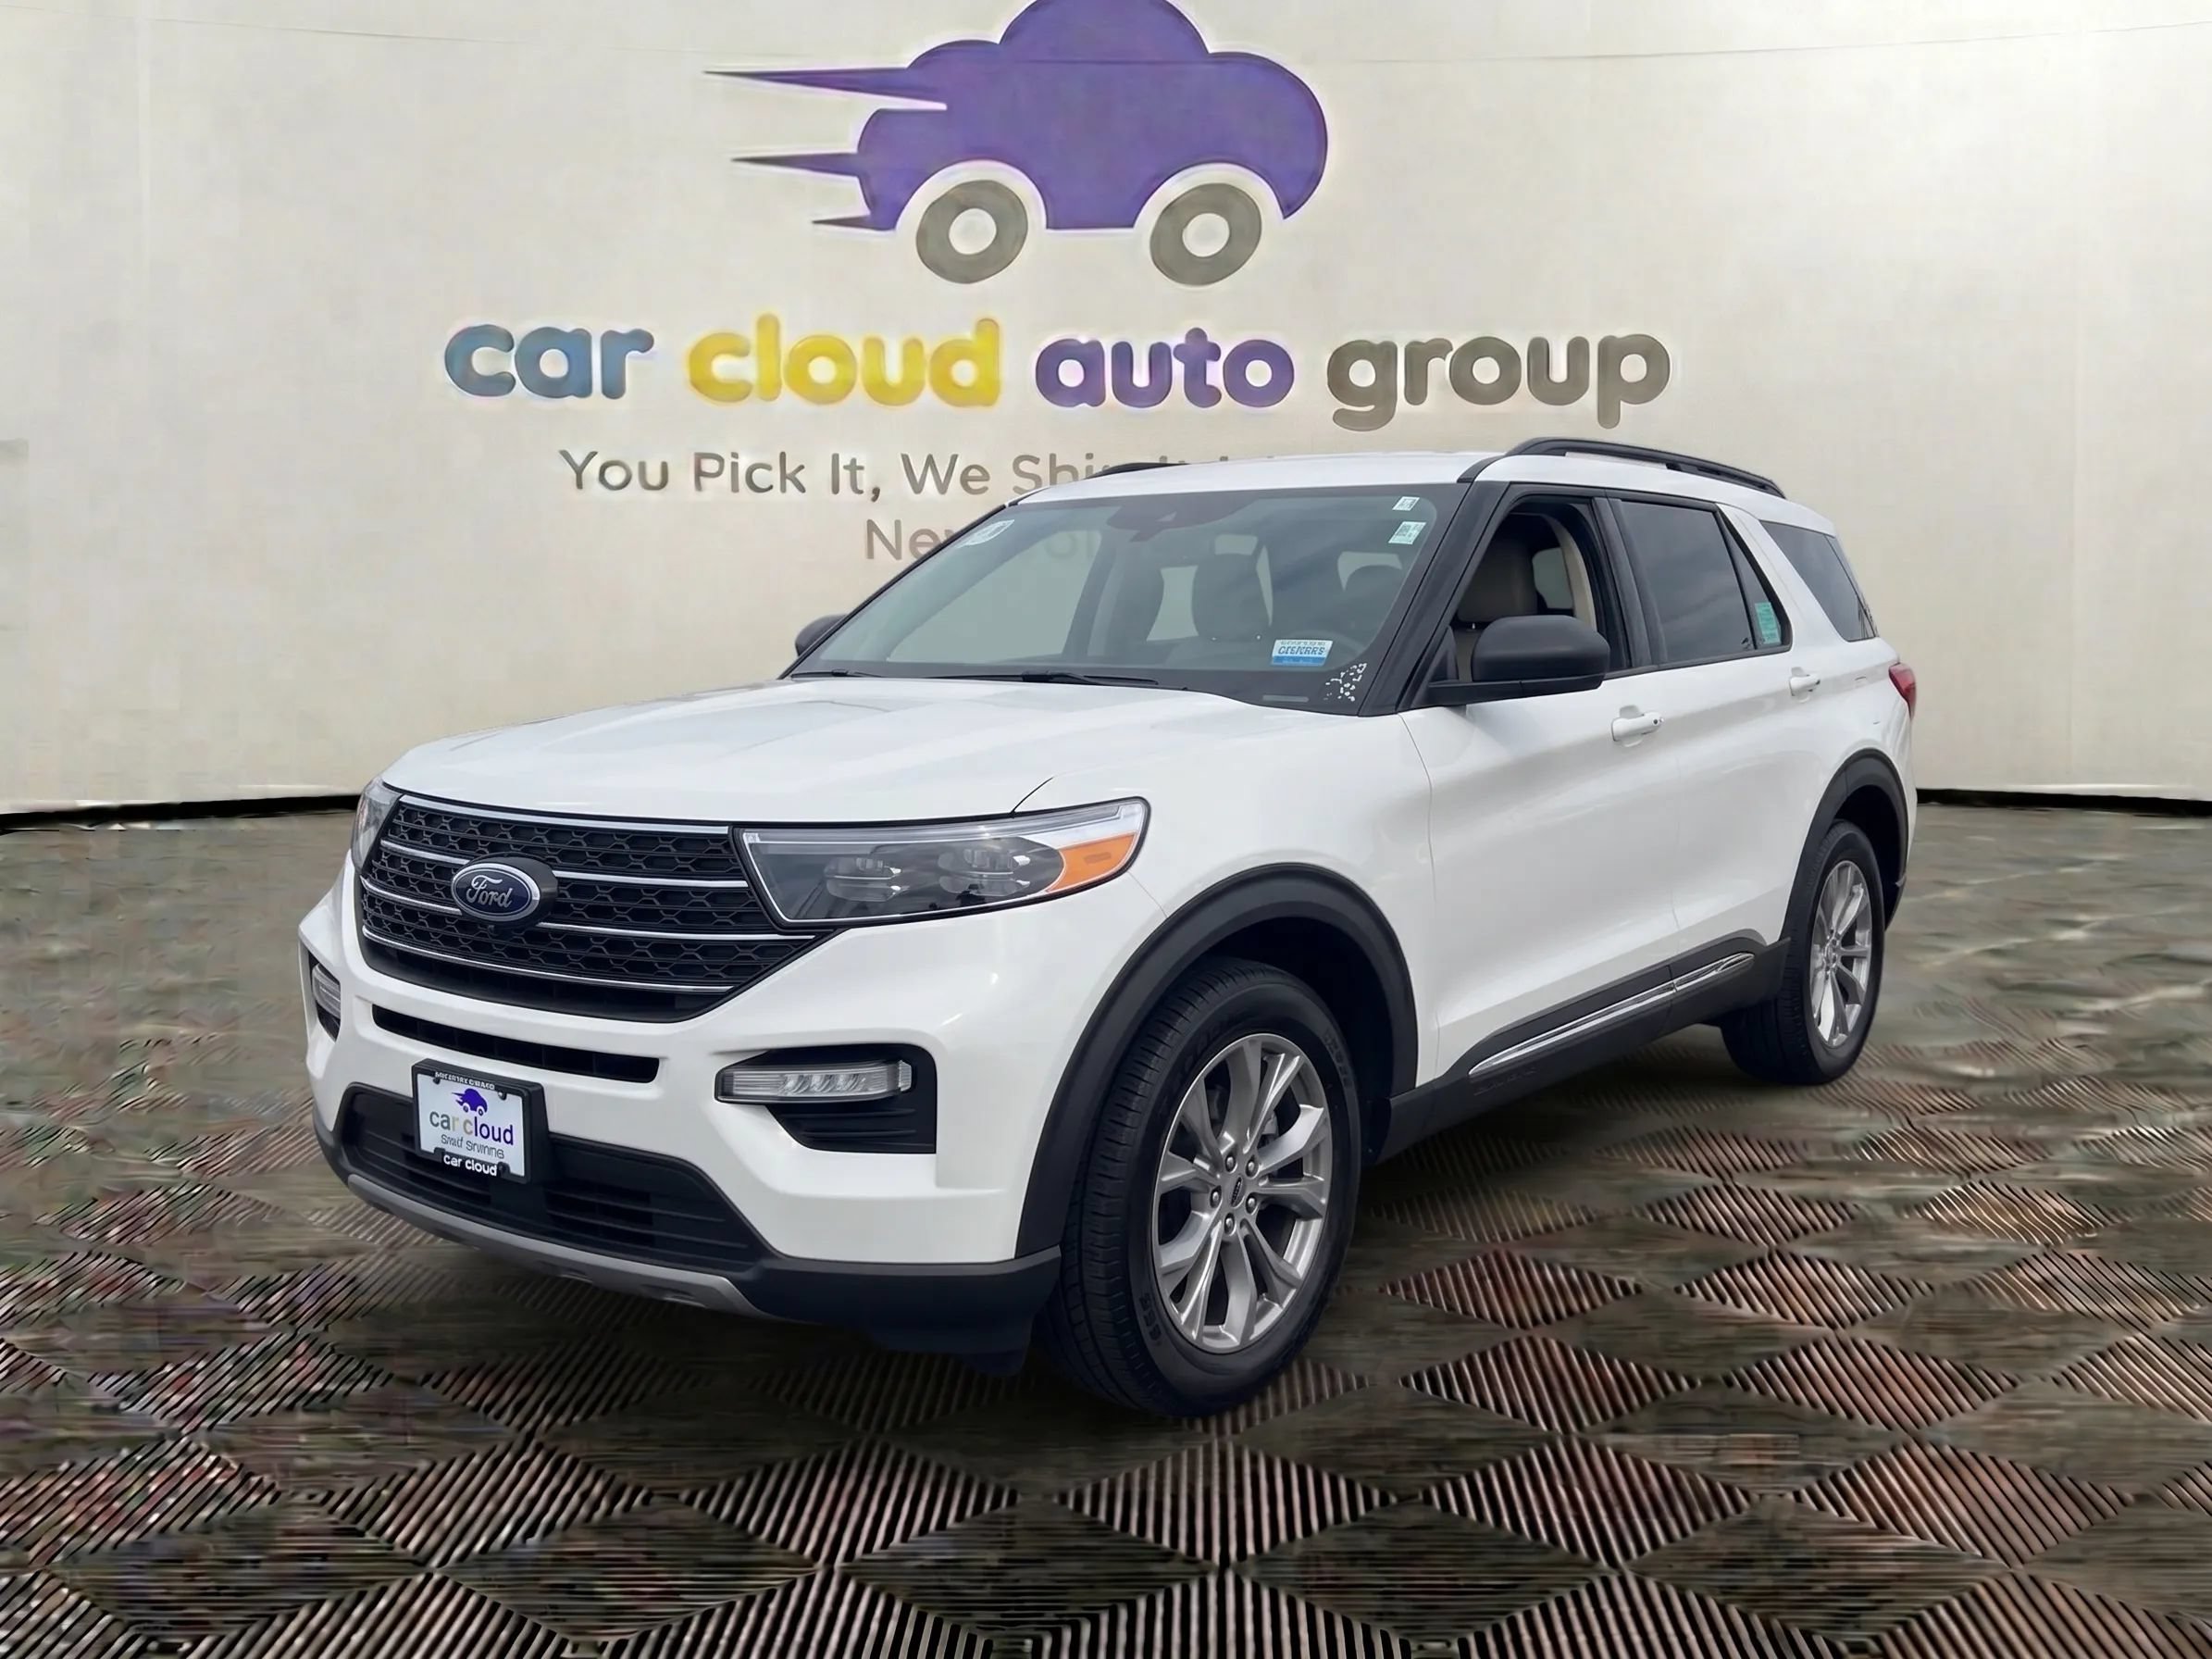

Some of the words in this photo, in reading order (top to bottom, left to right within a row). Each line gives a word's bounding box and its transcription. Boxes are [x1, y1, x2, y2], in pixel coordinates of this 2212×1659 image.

[445, 324, 654, 399] car
[688, 313, 1000, 406] cloud
[1036, 328, 1294, 407] auto
[1326, 334, 1671, 430] group
[559, 449, 668, 491] You
[693, 452, 806, 493] Pick
[831, 453, 881, 503] It,
[901, 454, 990, 494] We
[1012, 453, 1110, 494] Shi
[866, 519, 954, 560] Ne
[466, 874, 514, 907] Ford
[429, 1111, 459, 1131] car
[463, 1116, 514, 1145] cloud
[443, 1154, 462, 1167] car
[465, 1159, 497, 1176] cloud
